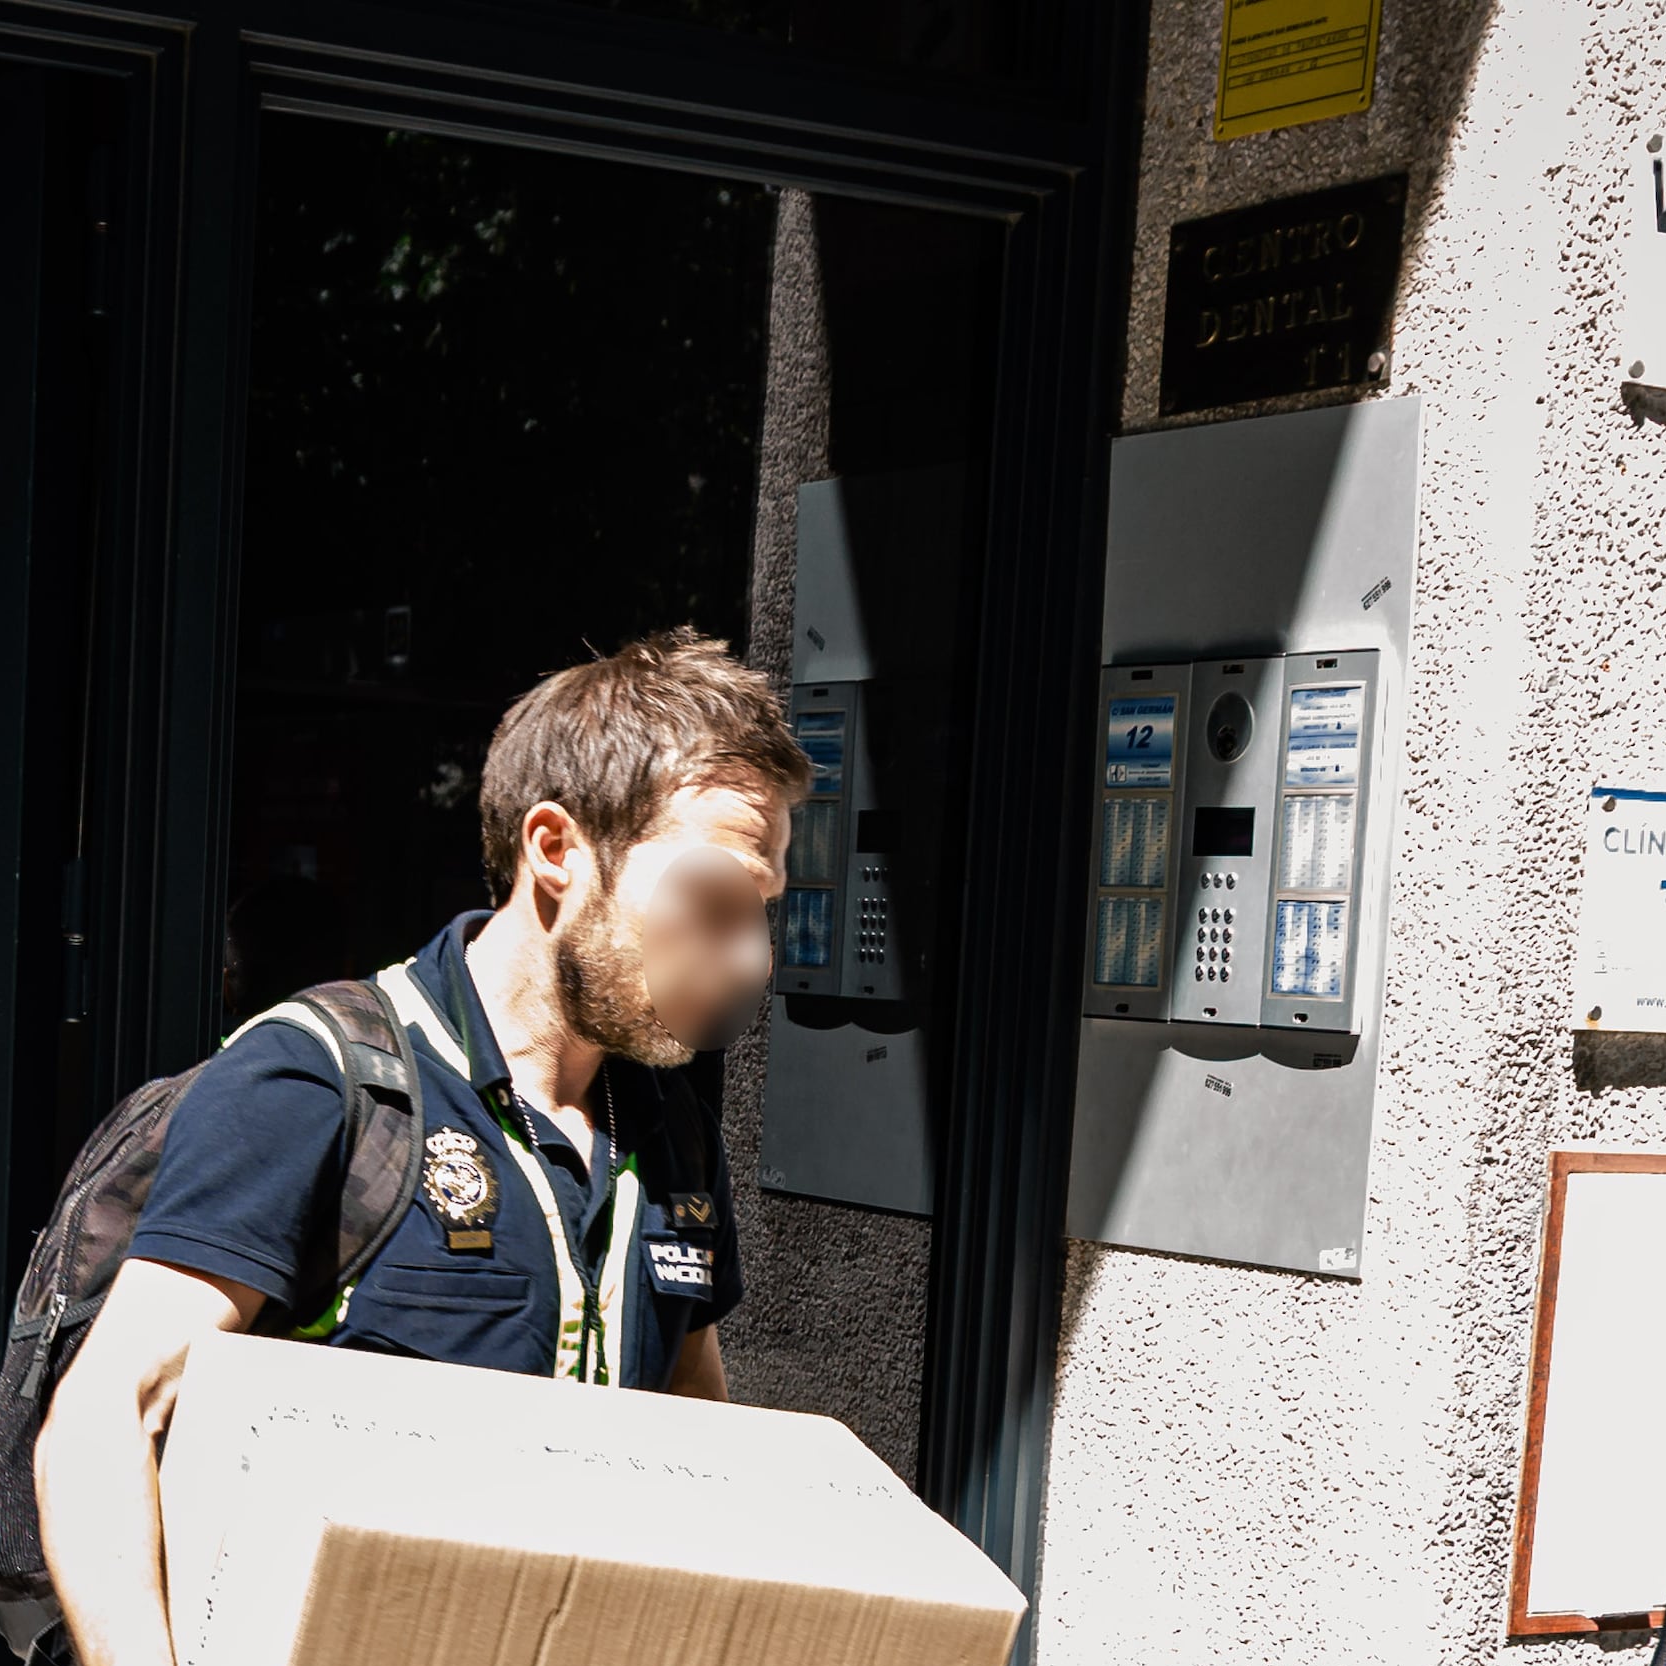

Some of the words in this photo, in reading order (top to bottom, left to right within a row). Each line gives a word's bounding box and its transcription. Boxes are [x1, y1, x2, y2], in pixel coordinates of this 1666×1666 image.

[1201, 211, 1365, 283] CENTRO
[1195, 280, 1354, 349] DENTAL
[1125, 724, 1154, 750] 12
